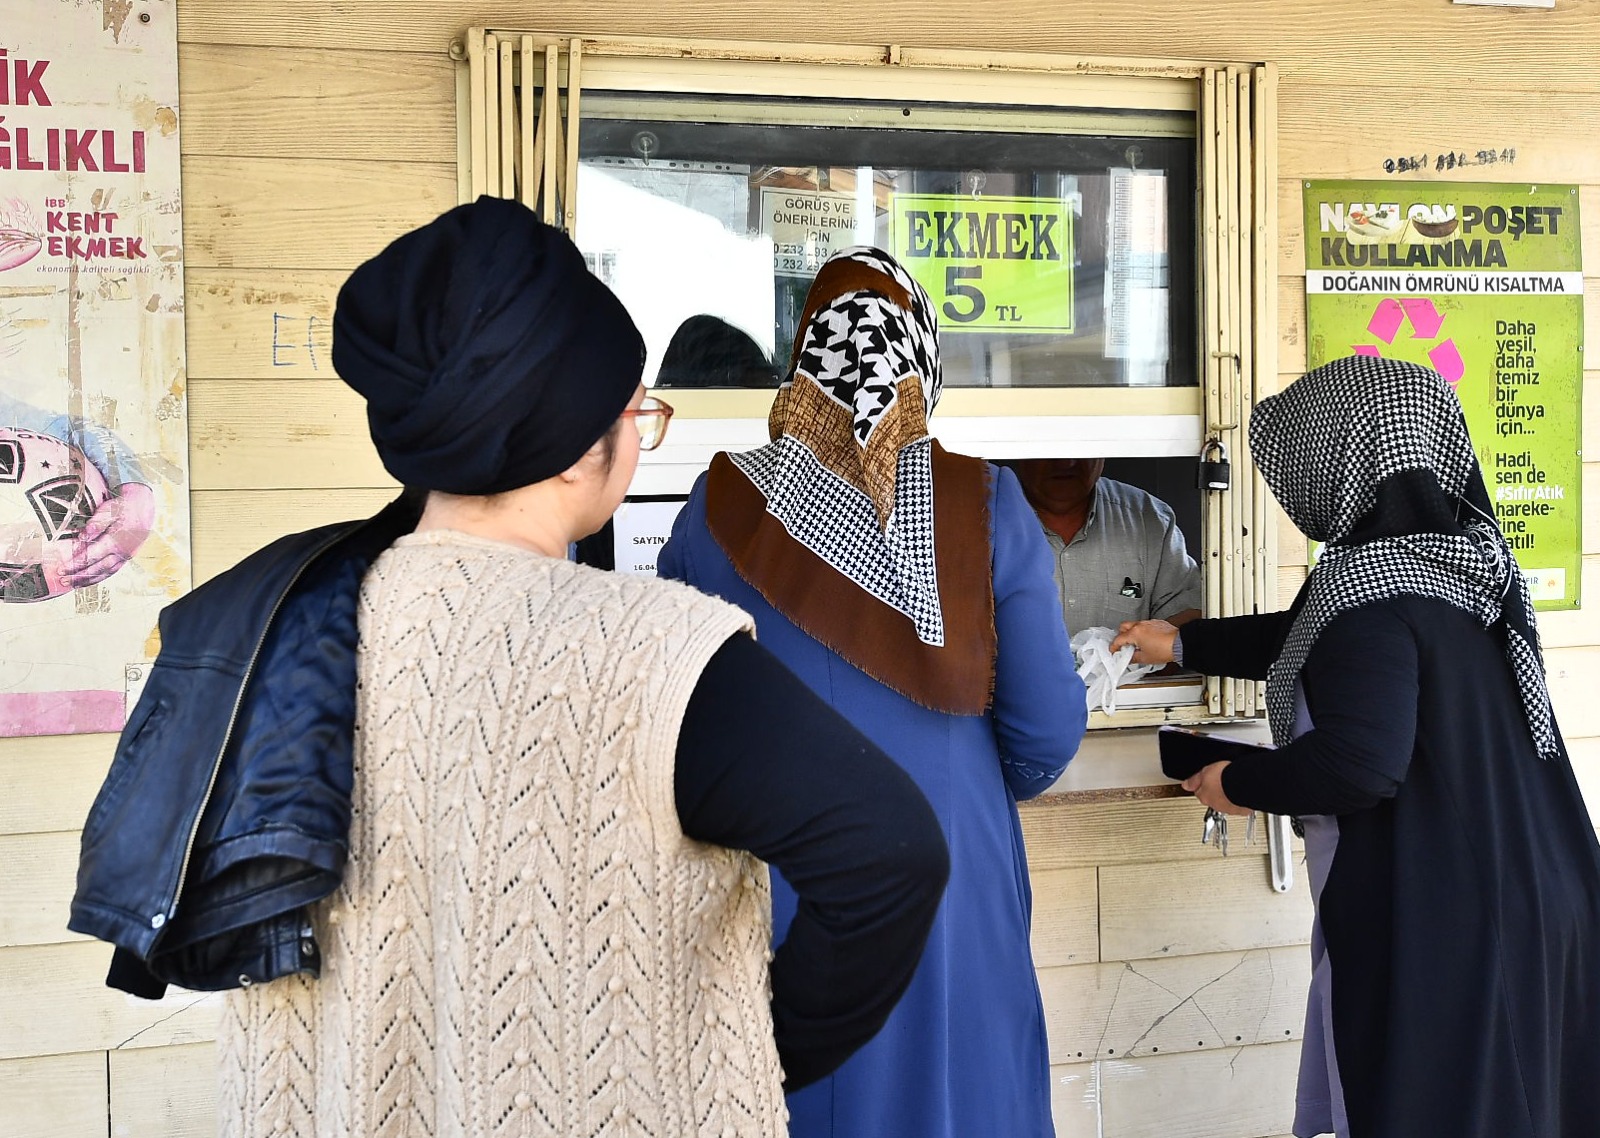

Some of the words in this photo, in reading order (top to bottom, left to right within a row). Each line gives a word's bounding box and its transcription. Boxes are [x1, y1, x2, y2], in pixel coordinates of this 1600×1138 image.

[785, 196, 831, 214] GÖRÜŞ
[834, 202, 850, 214] VE
[47, 211, 118, 235] KENT
[1462, 205, 1563, 241] POŞET
[904, 210, 1060, 261] EKMEK
[47, 235, 147, 261] EKMEK
[783, 244, 804, 256] 232
[1321, 237, 1508, 267] KULLANMA
[783, 259, 803, 270] 232
[1322, 272, 1401, 292] DOĞANIN
[1405, 273, 1479, 292] ÖMRÜNÜ
[1484, 276, 1565, 292] KISALTMA
[942, 265, 986, 322] 5
[995, 305, 1022, 321] TL
[1496, 320, 1536, 335] Daha
[1496, 336, 1537, 354] yeşil,
[1496, 353, 1535, 368] daha
[1496, 369, 1540, 385] temiz
[1496, 386, 1518, 402] bir
[1496, 402, 1545, 421] dünya
[1496, 419, 1535, 438] için...
[1496, 452, 1535, 468] Hadi,
[1496, 471, 1522, 484] sen
[1527, 468, 1546, 483] de
[1496, 501, 1555, 516] hareke-
[633, 536, 665, 545] SAYIN
[1505, 534, 1534, 549] atıl!
